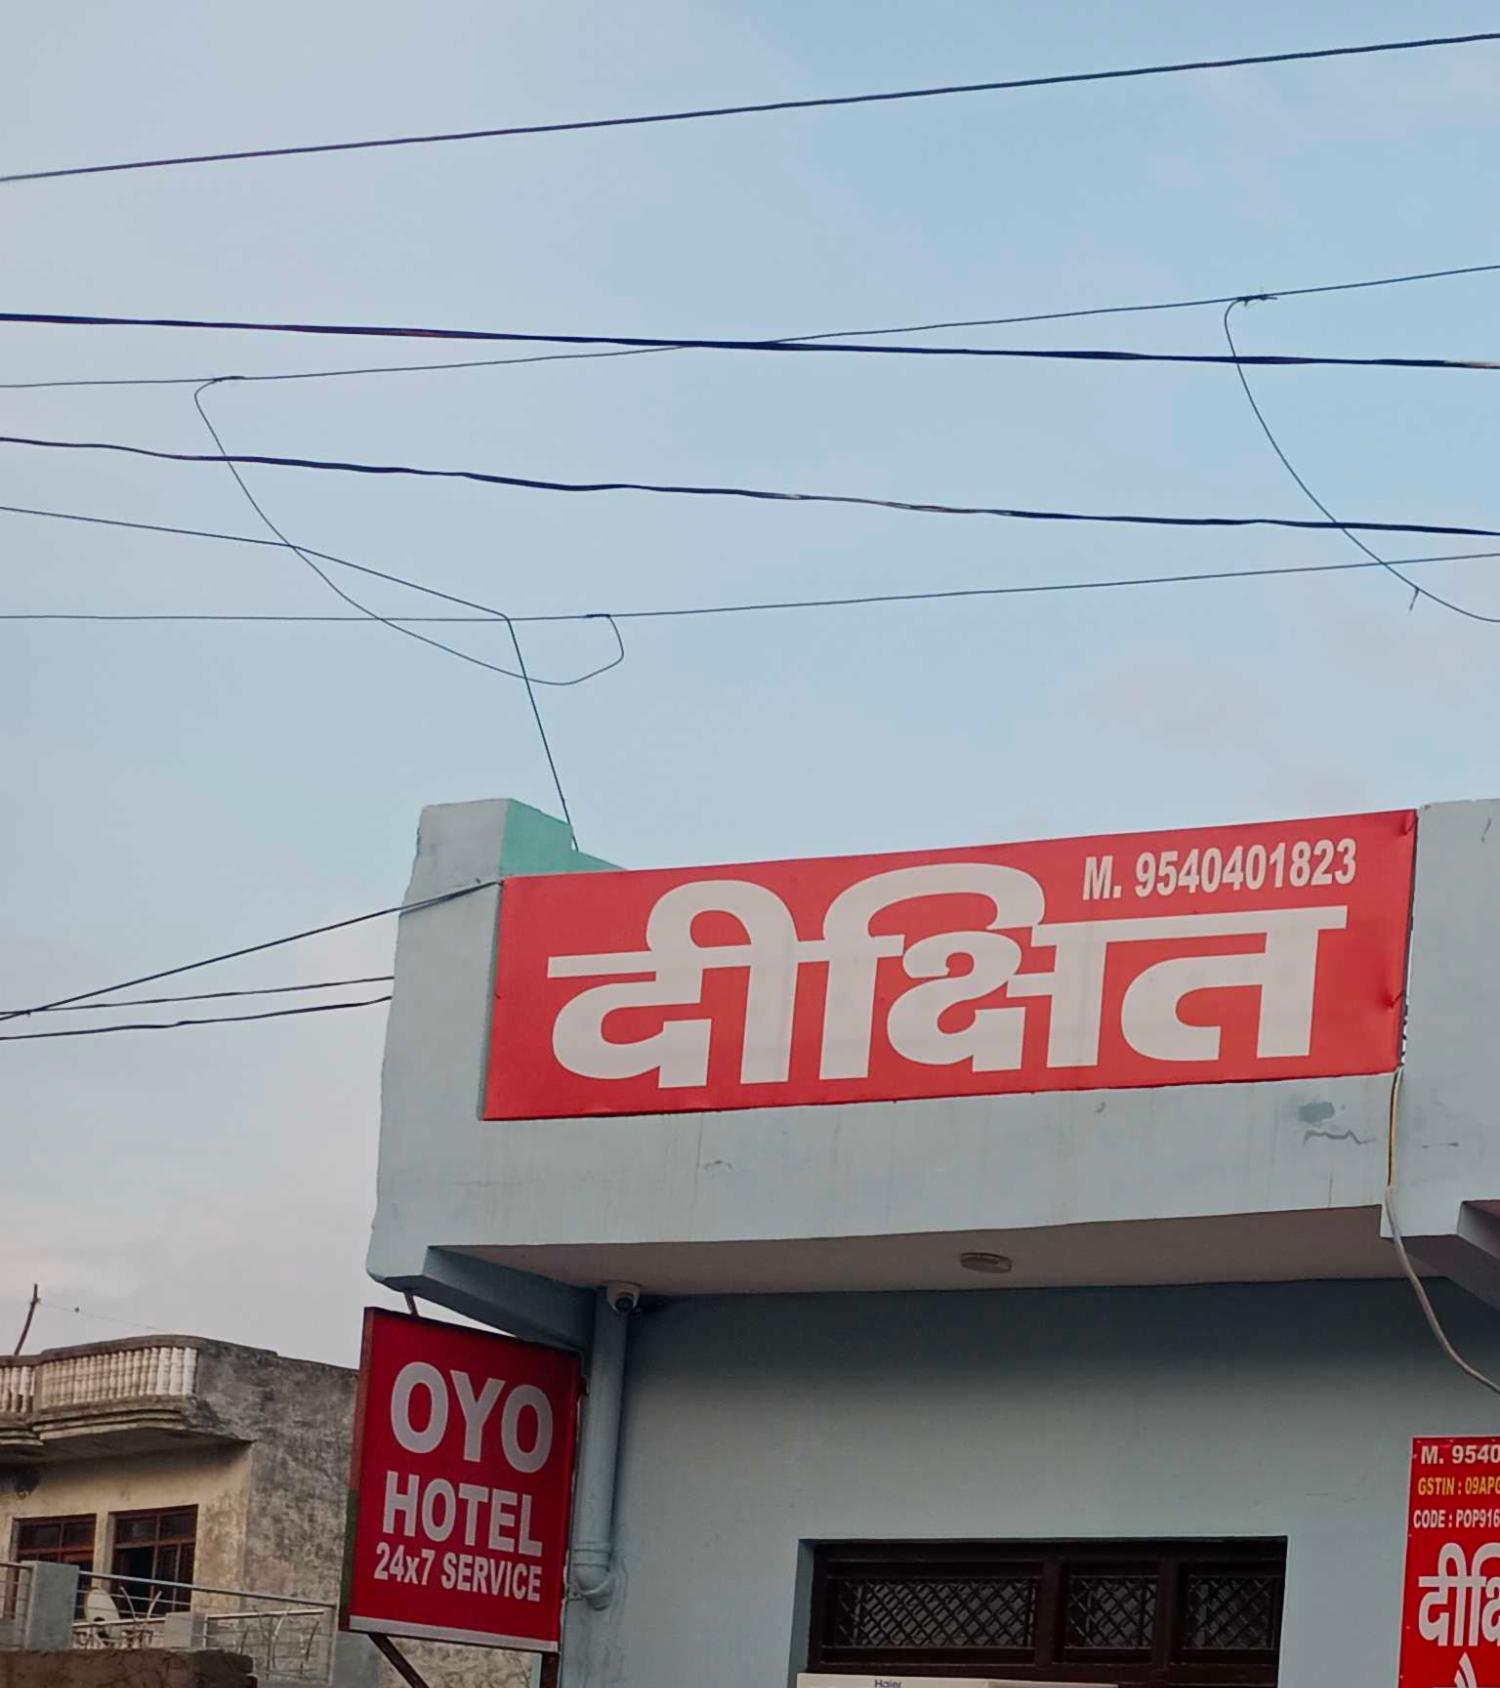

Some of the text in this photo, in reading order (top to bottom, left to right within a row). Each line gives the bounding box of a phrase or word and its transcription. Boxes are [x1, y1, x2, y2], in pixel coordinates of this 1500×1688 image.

[1083, 838, 1356, 900] M. 9540401823
[547, 863, 1347, 1088] दीक्षित
[390, 1362, 553, 1473] OYO
[1420, 1445, 1444, 1465] M.
[382, 1470, 543, 1557] HOTEL
[1417, 1477, 1455, 1495] GSTIN
[1413, 1510, 1446, 1529] CODE
[374, 1542, 543, 1602] 24x7 SERVICE
